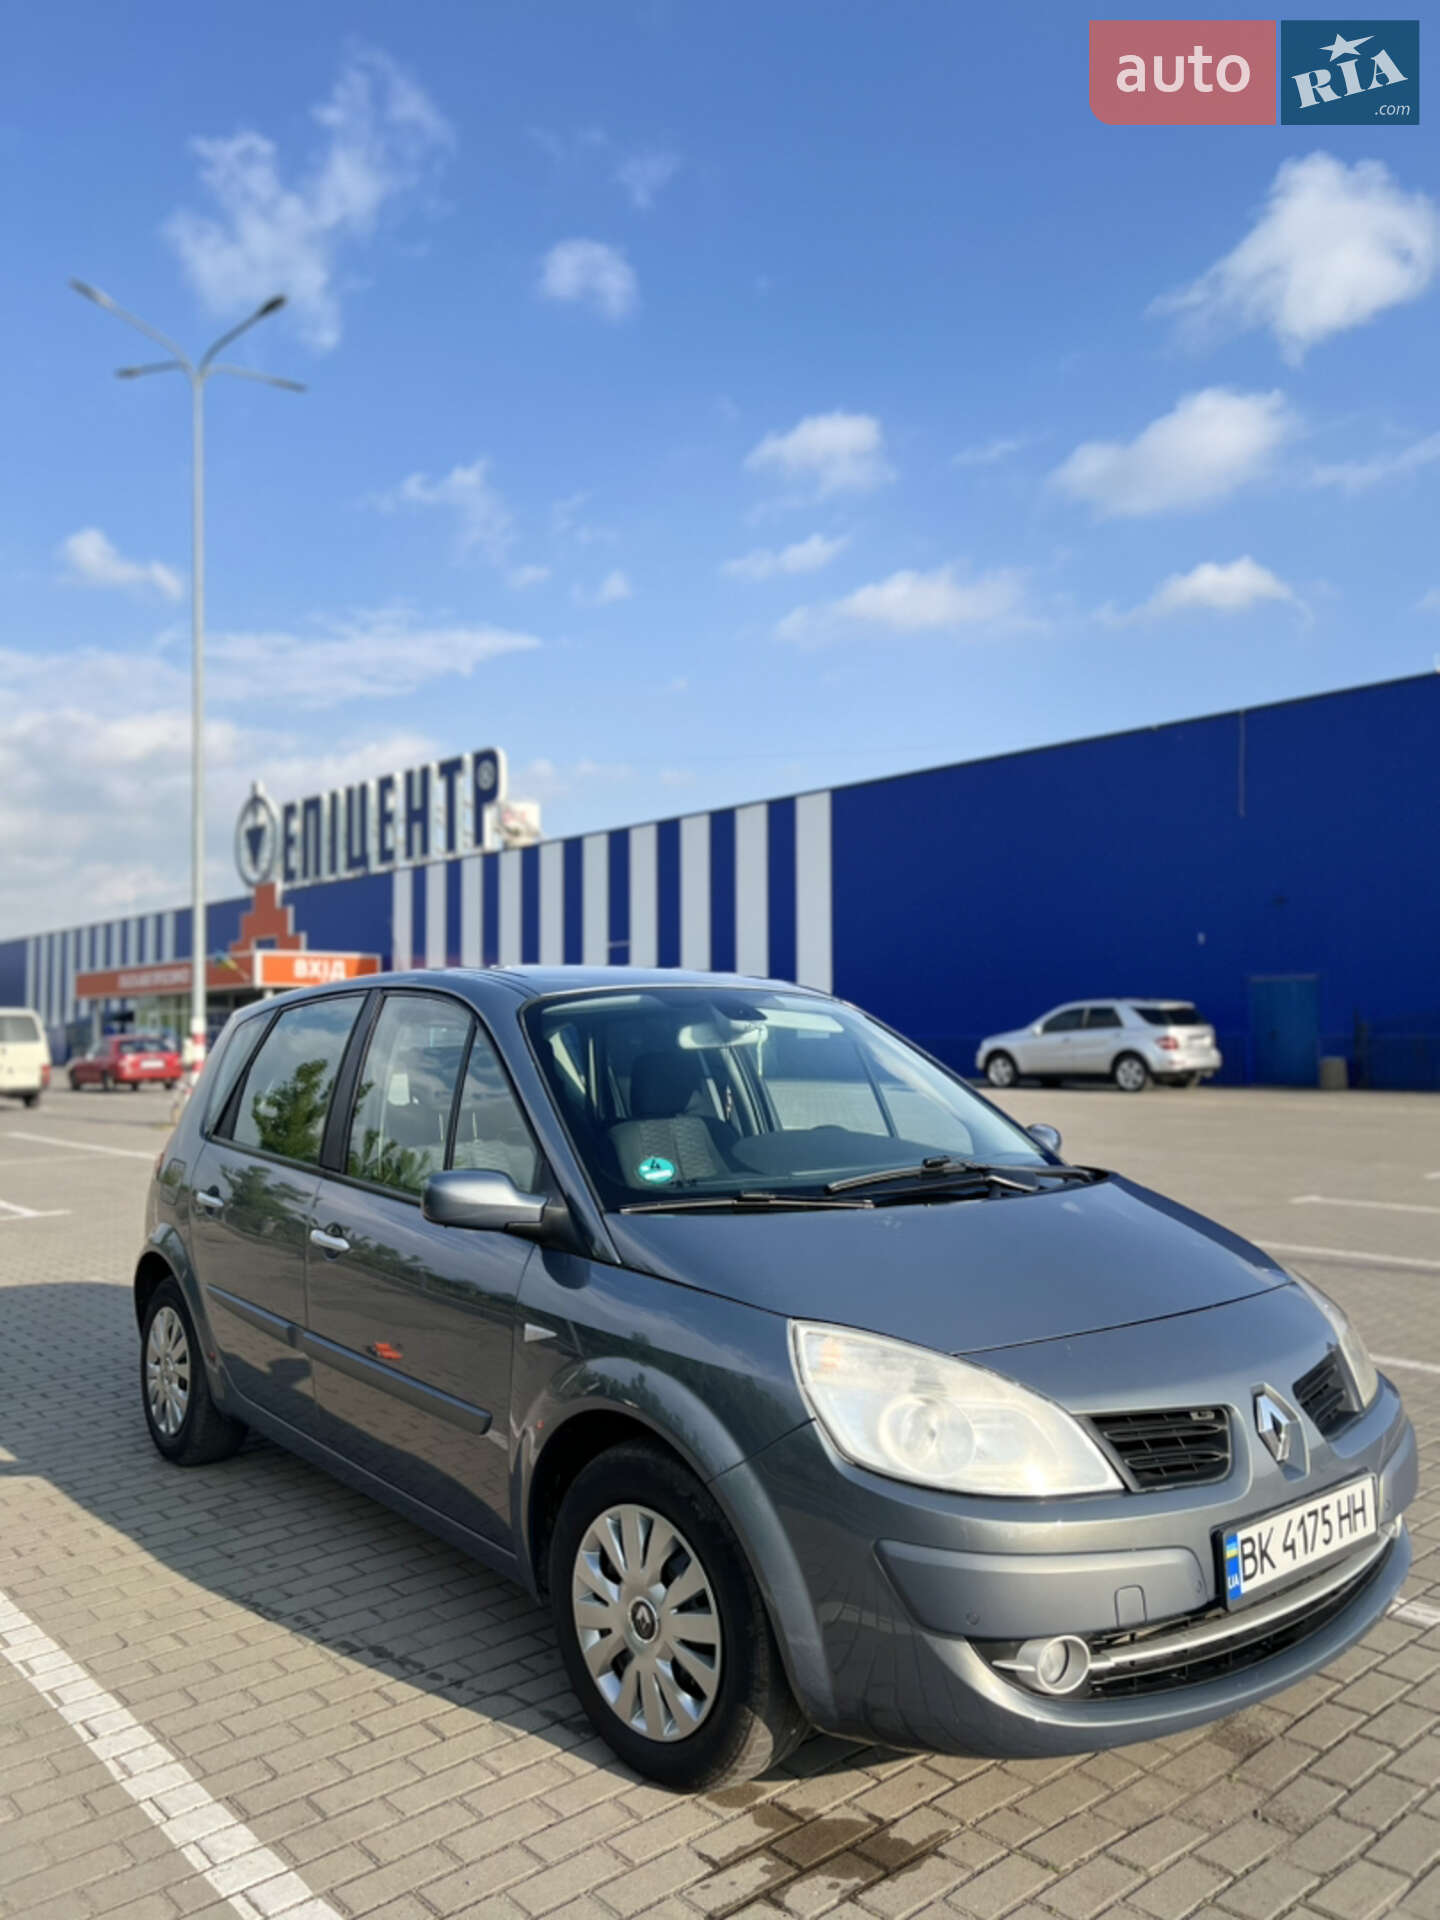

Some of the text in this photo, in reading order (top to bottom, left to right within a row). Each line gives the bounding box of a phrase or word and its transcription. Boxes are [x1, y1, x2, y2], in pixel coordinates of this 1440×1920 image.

[283, 747, 503, 883] ЕПІЦЕНТР
[294, 957, 346, 981] ВХІД
[1240, 1488, 1367, 1583] BK 4175 HH
